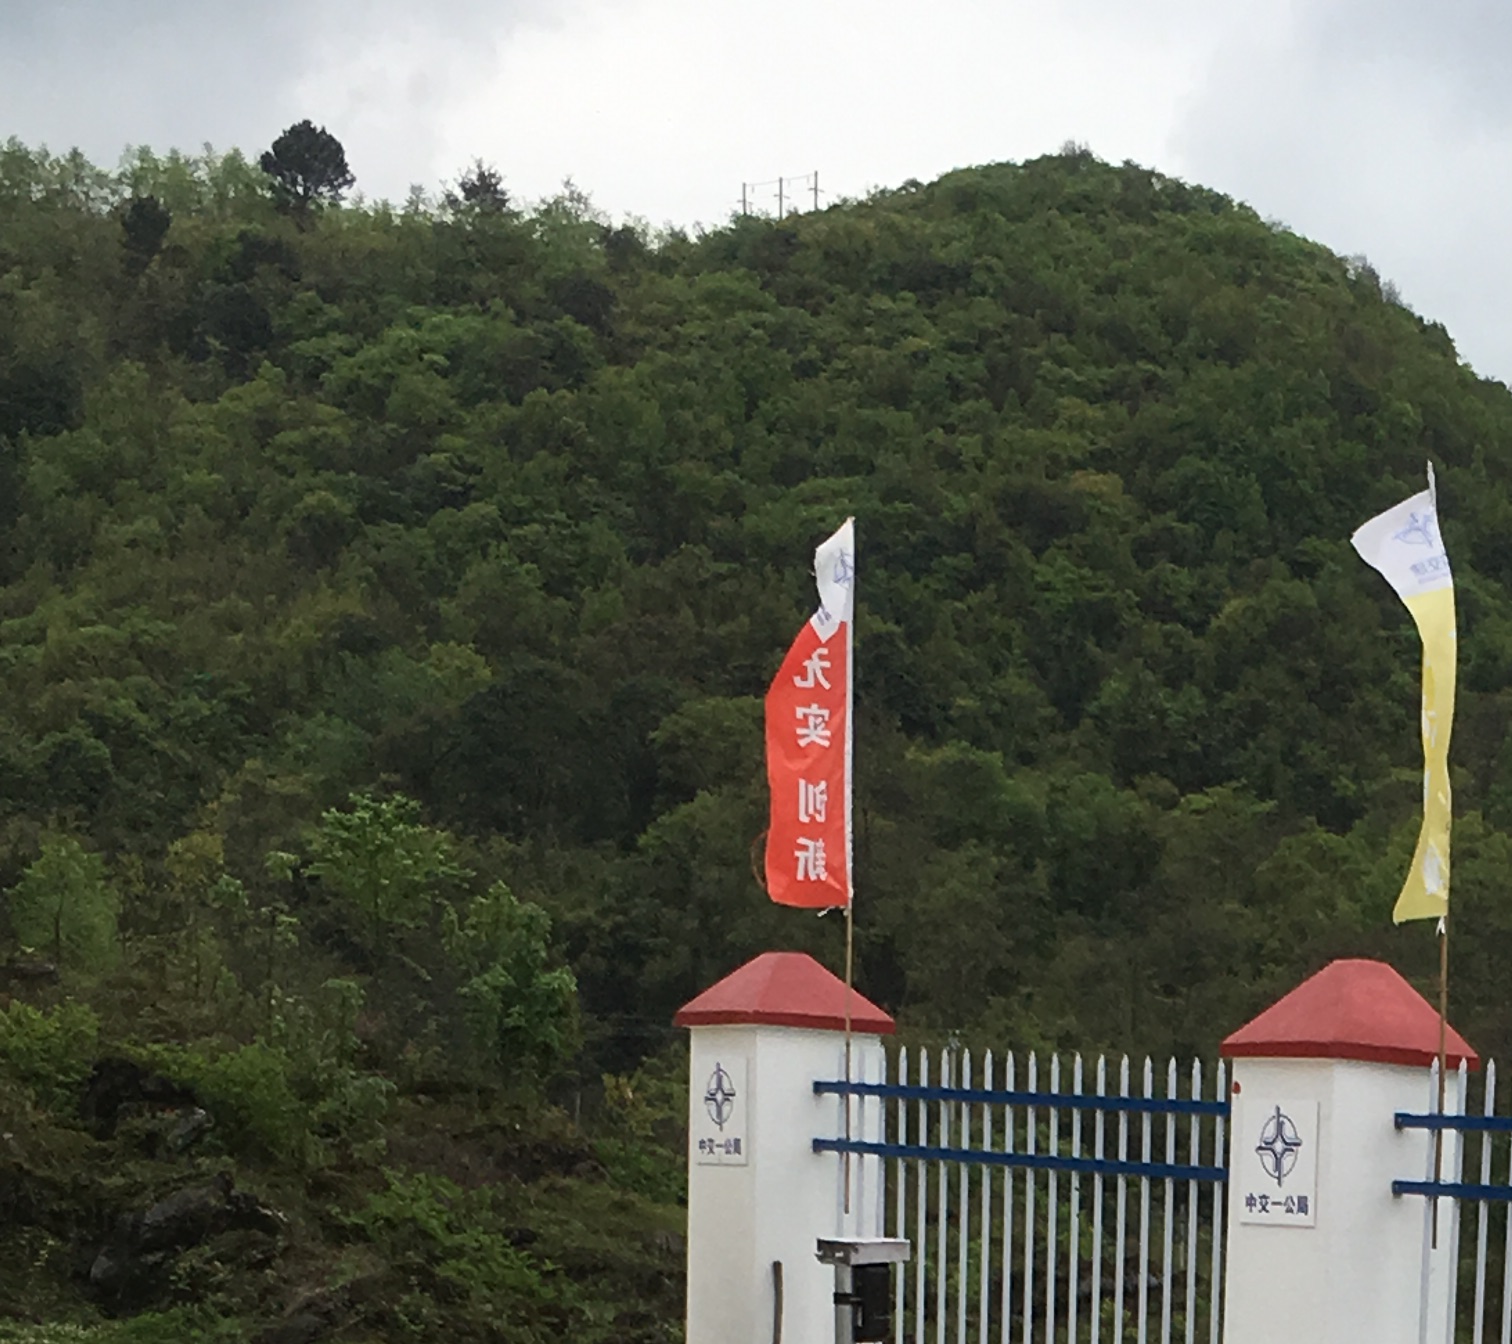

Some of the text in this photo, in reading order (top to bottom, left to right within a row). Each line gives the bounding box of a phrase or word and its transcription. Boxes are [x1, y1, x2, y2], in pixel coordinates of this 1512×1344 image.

[1245, 1192, 1309, 1216] 中交一公局
